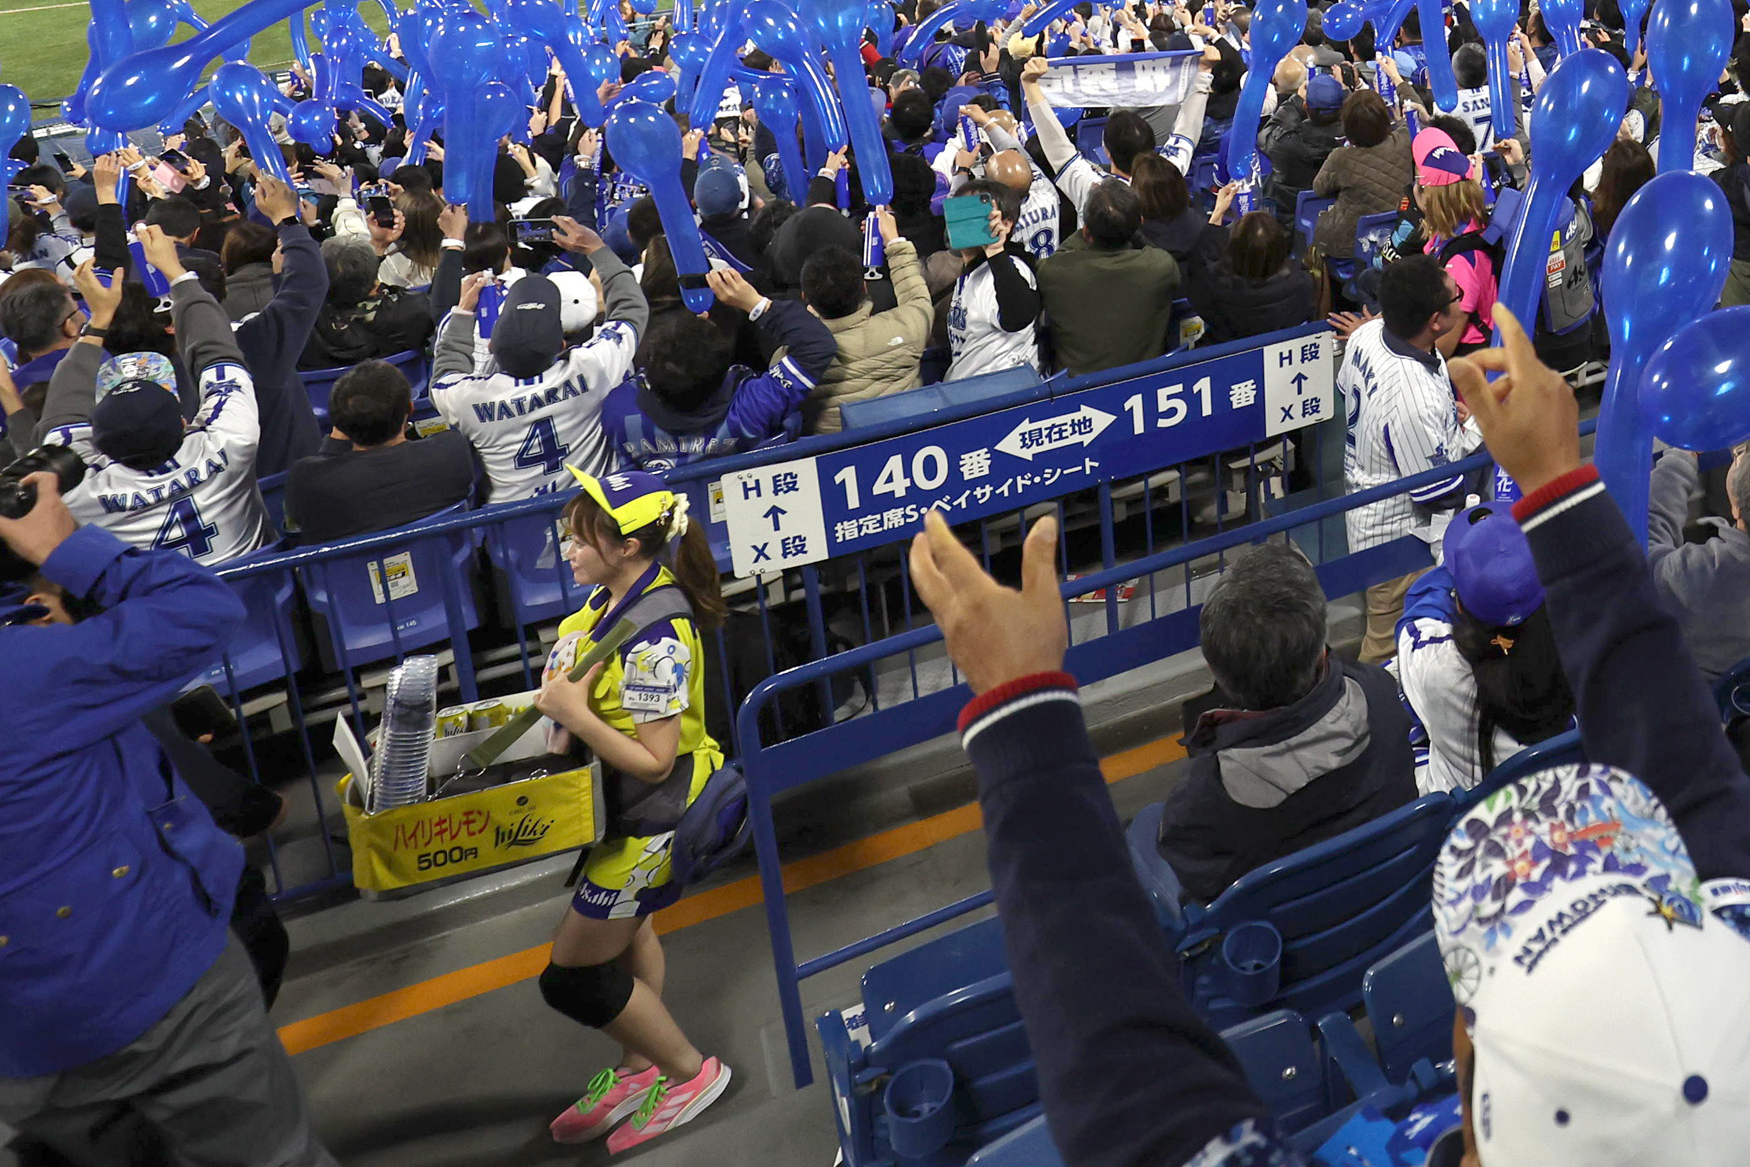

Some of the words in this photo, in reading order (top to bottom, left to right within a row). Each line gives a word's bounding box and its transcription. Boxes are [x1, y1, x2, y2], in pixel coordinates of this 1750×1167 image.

[1461, 98, 1490, 113] SAN
[472, 373, 590, 424] WATARAI
[514, 415, 571, 476] 4
[833, 445, 949, 511] 140
[959, 447, 994, 482] 番
[1018, 416, 1095, 451] 現在地
[1123, 376, 1215, 436] 151
[1229, 382, 1258, 411] 番
[98, 447, 229, 514] WATARAI
[150, 494, 220, 560] 4
[637, 693, 661, 703] 1393
[393, 808, 491, 852] ハイリキレモン
[417, 846, 478, 872] 500円
